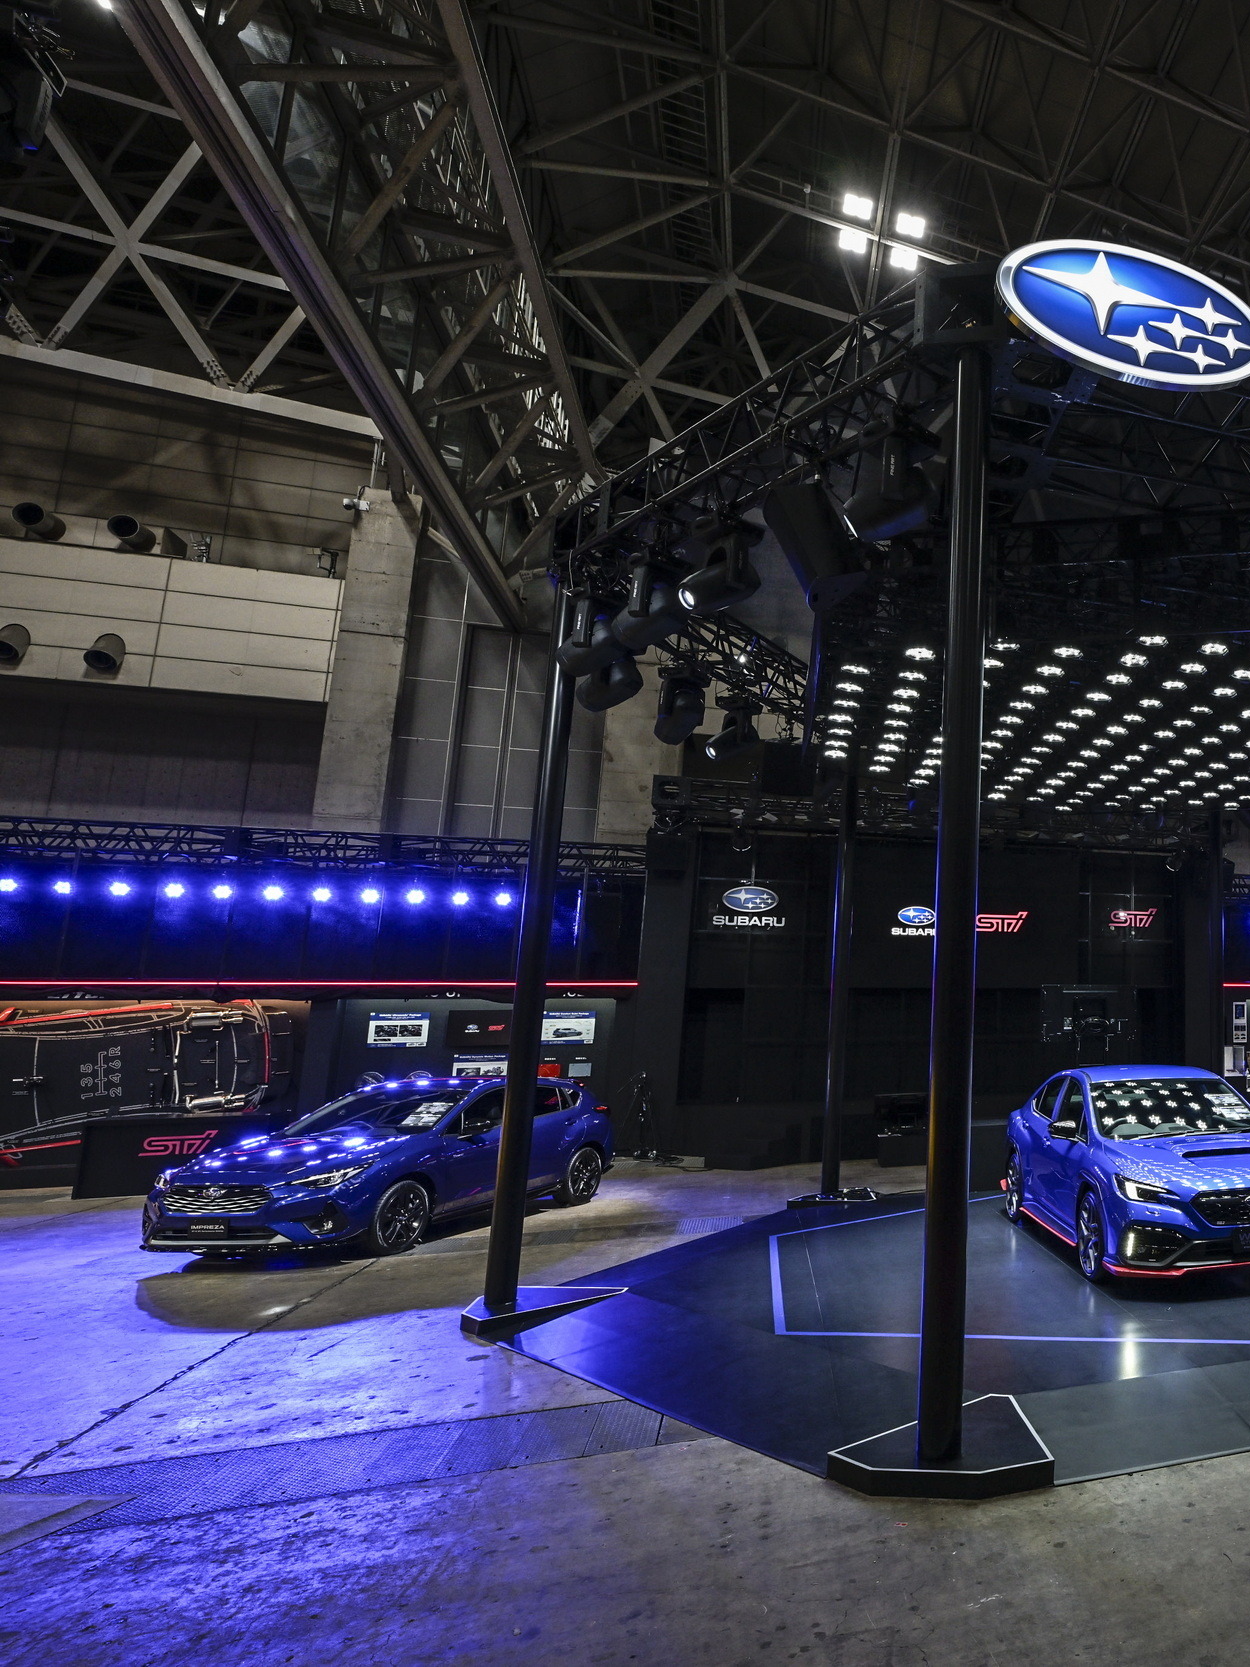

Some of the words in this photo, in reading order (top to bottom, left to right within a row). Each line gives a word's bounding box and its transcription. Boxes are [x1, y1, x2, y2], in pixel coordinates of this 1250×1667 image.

[712, 914, 785, 928] SUBARU
[891, 927, 936, 936] SUBAR
[138, 1130, 219, 1157] STI
